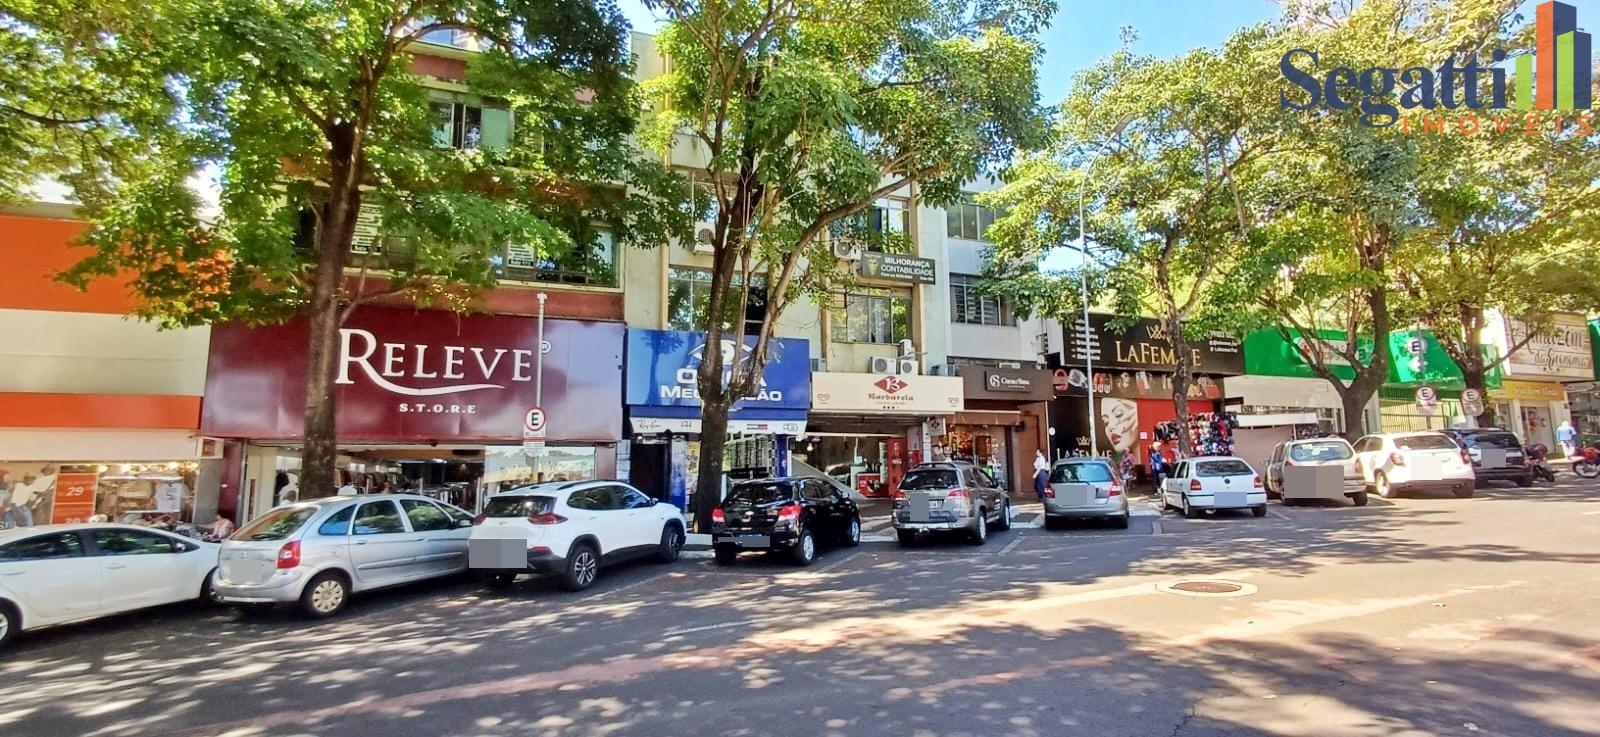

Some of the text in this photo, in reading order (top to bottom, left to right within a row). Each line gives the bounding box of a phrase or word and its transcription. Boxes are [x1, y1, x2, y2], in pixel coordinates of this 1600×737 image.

[884, 256, 930, 268] MILHORANÇA
[880, 264, 934, 276] CONTABILIDADE
[1115, 341, 1202, 367] LAFEME
[334, 328, 532, 396] RELEVE
[1421, 388, 1430, 398] E
[531, 412, 540, 426] E
[65, 486, 85, 497] 29
